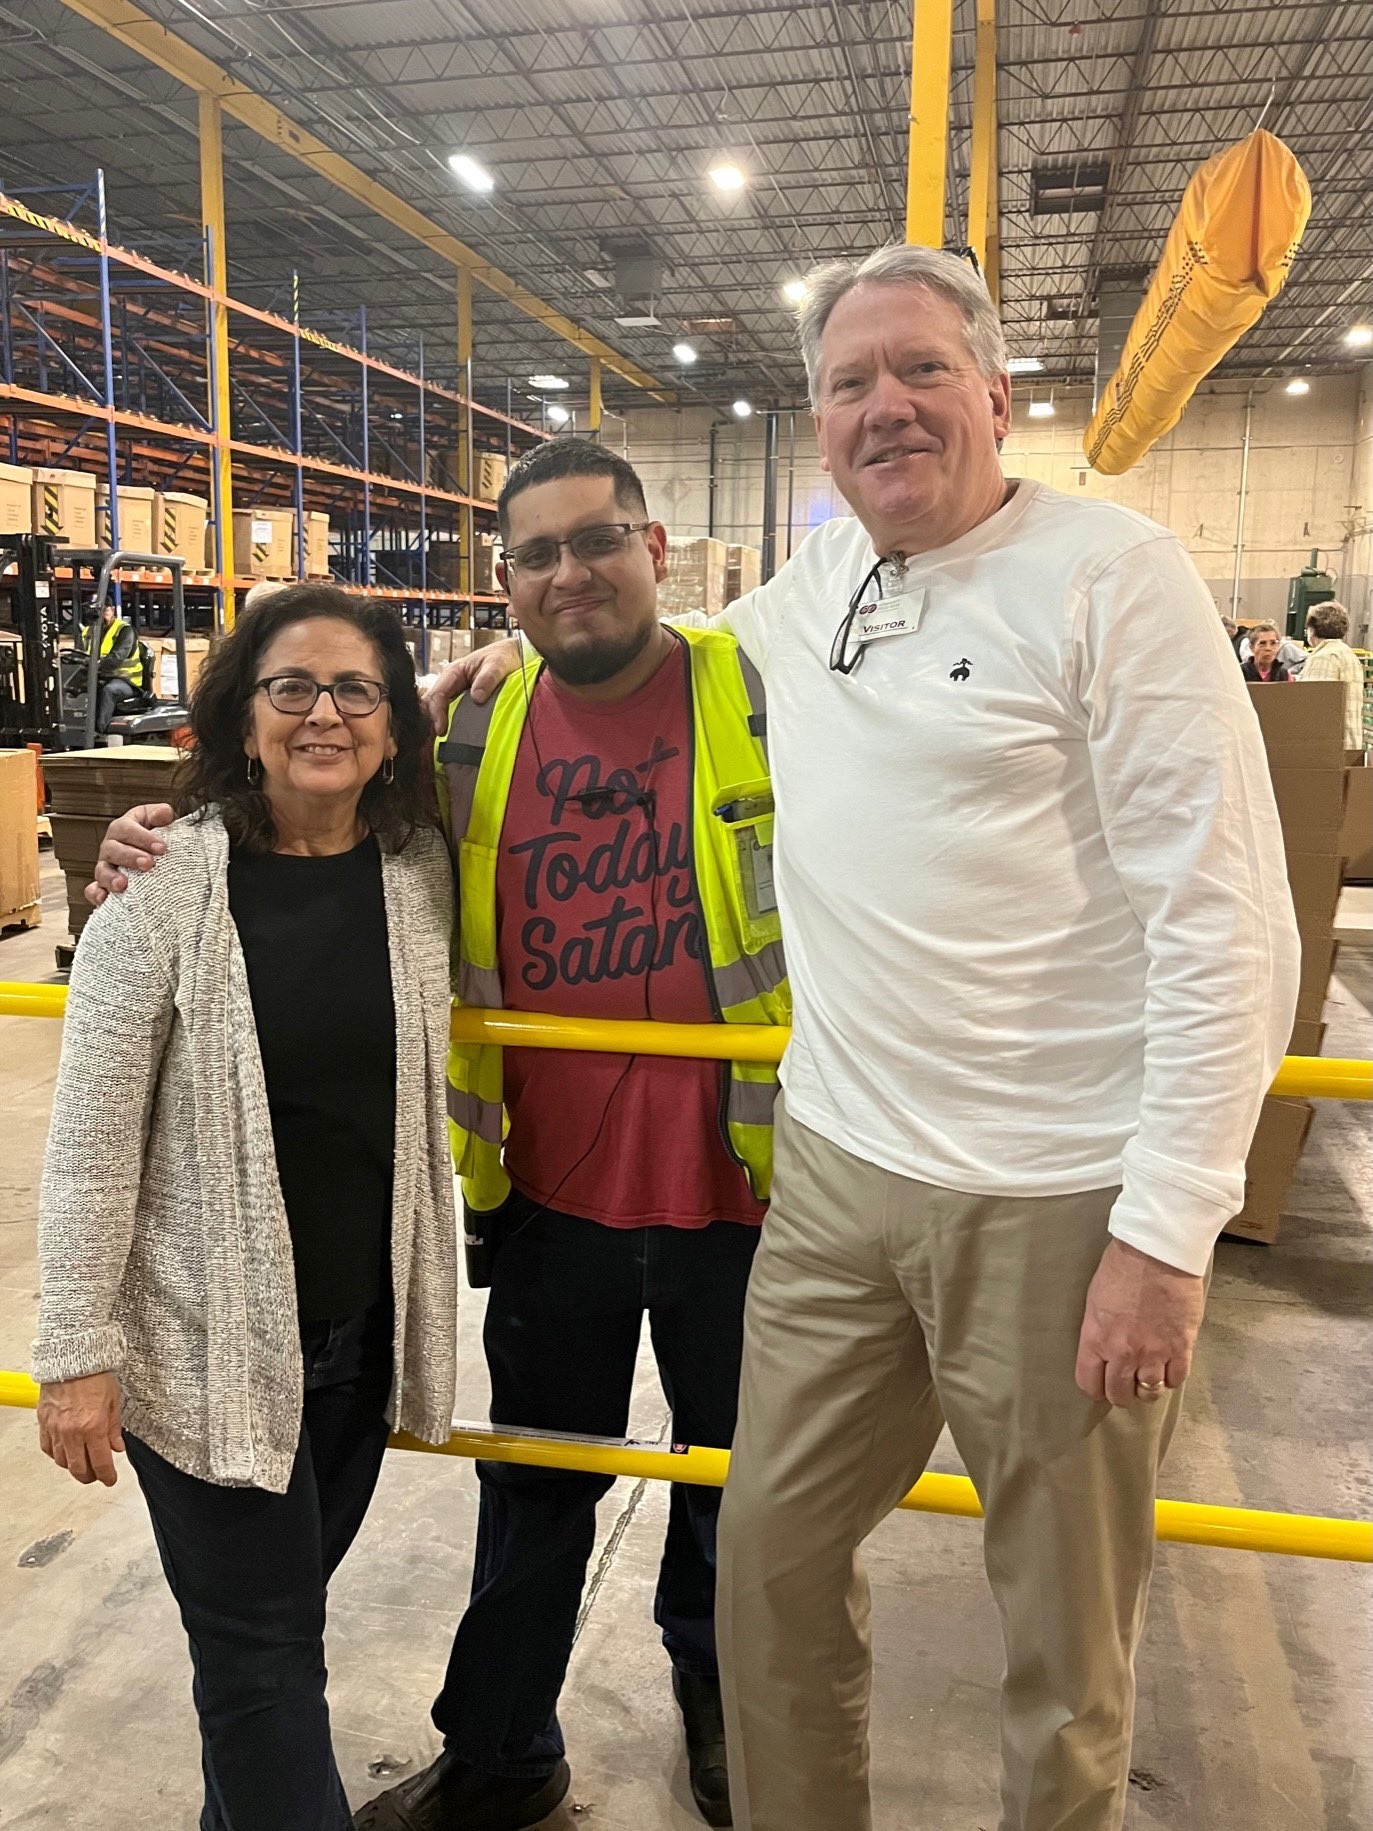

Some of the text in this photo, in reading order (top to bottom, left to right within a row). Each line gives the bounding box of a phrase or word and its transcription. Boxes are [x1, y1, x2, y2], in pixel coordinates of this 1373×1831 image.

[864, 620, 905, 632] VISITOR
[537, 737, 678, 825] Not
[509, 819, 692, 909] Today
[522, 896, 702, 990] Satan
